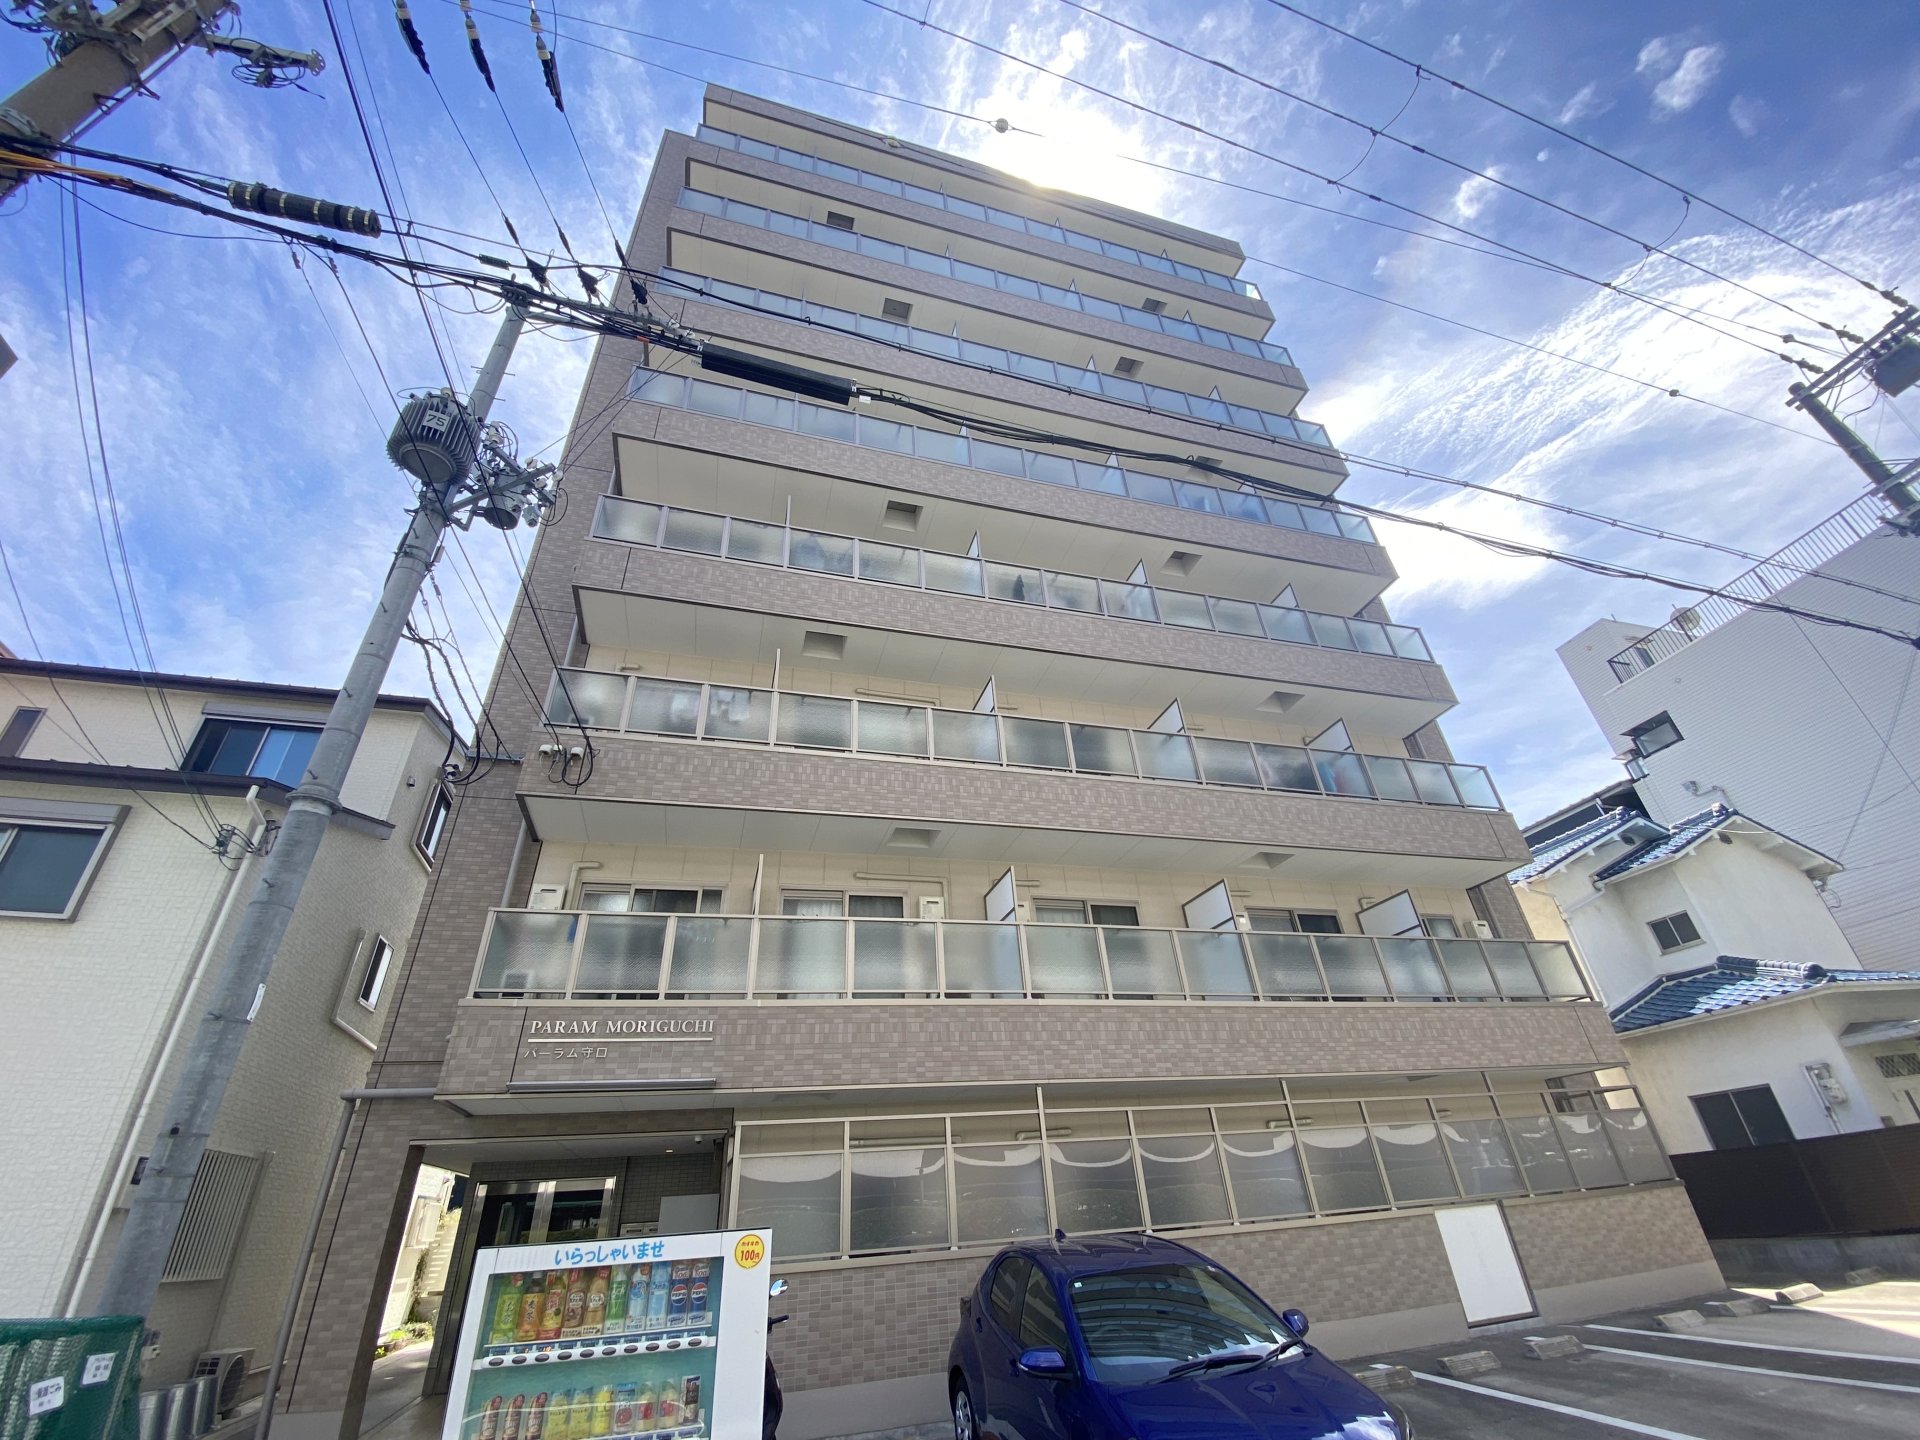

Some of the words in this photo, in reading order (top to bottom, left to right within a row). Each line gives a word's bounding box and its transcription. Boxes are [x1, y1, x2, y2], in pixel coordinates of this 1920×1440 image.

[426, 413, 447, 426] 75
[530, 1020, 598, 1034] PARAM
[606, 1019, 715, 1033] MORIGUCHI
[523, 1046, 608, 1059] パーラム守口
[554, 1240, 665, 1266] いらっしゃいませ
[740, 1249, 760, 1262] 100円
